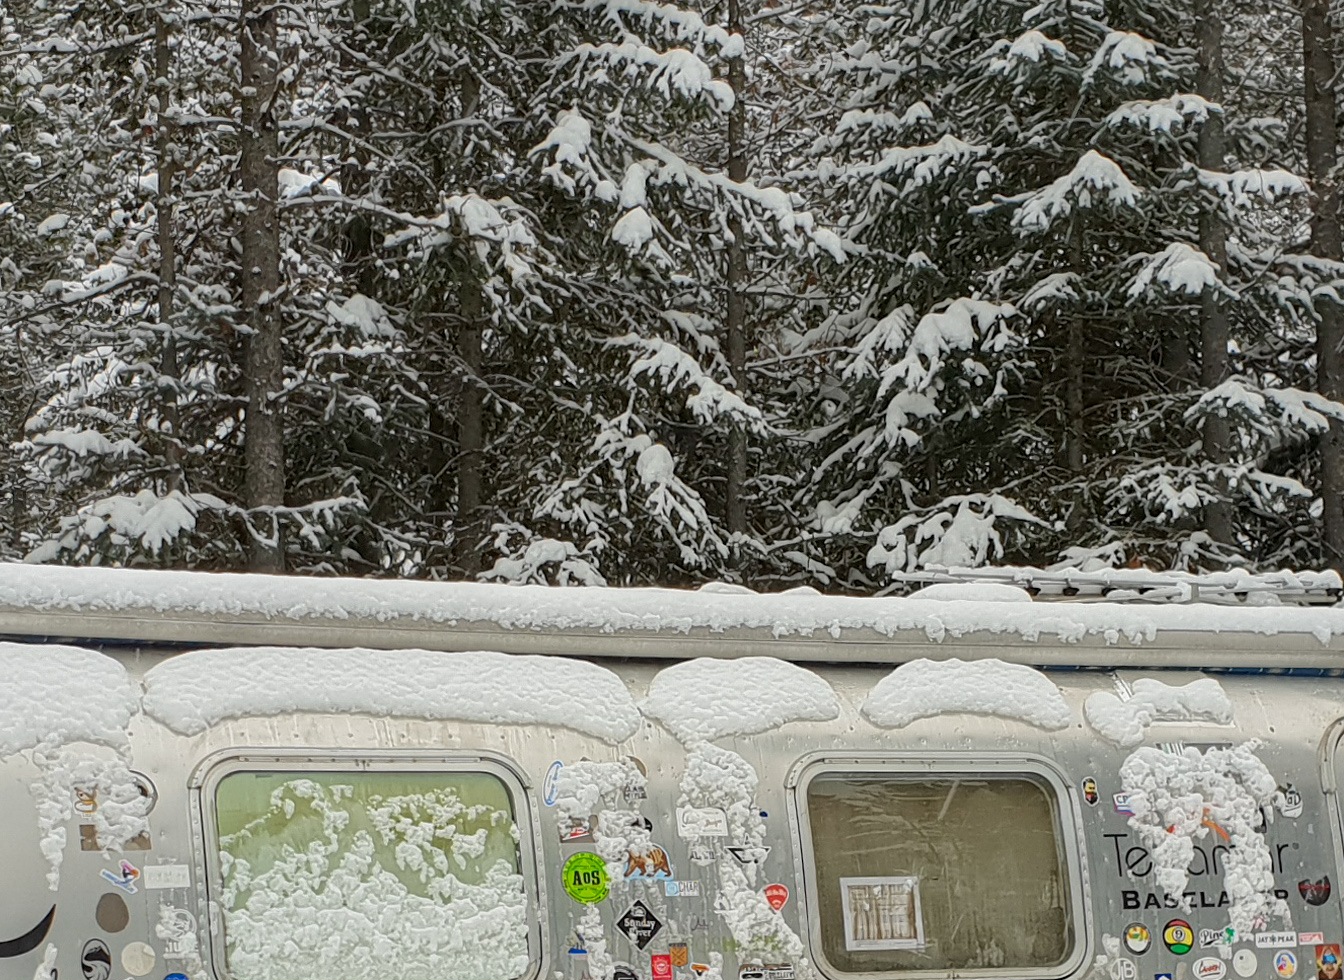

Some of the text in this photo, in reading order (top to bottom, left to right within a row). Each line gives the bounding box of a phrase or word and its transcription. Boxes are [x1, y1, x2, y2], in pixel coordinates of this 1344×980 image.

[573, 870, 601, 885] AoS
[1122, 890, 1289, 910] BASELAR
[623, 917, 655, 930] Sunday
[1277, 935, 1296, 944] PEAK
